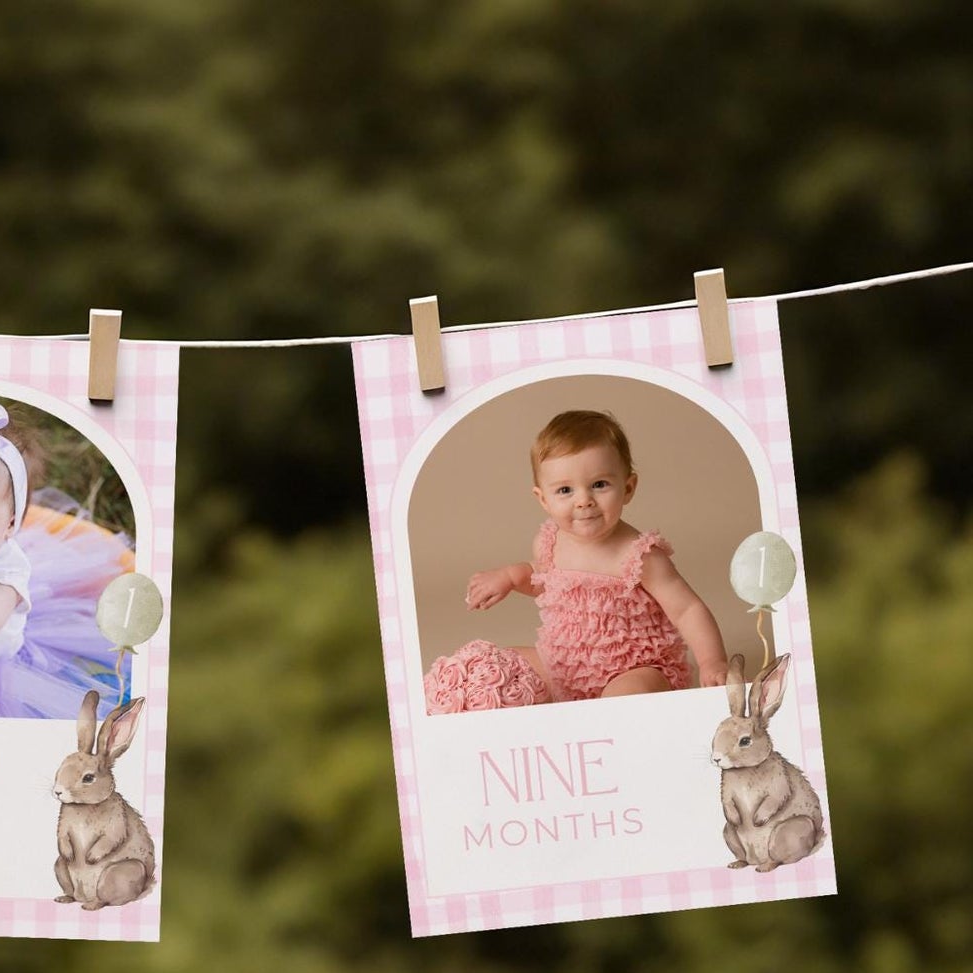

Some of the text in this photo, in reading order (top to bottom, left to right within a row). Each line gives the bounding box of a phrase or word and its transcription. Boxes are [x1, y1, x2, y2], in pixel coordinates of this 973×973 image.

[759, 546, 766, 588] 1
[123, 587, 136, 628] 1
[479, 738, 618, 805] NINE
[464, 808, 644, 850] MONTHS
